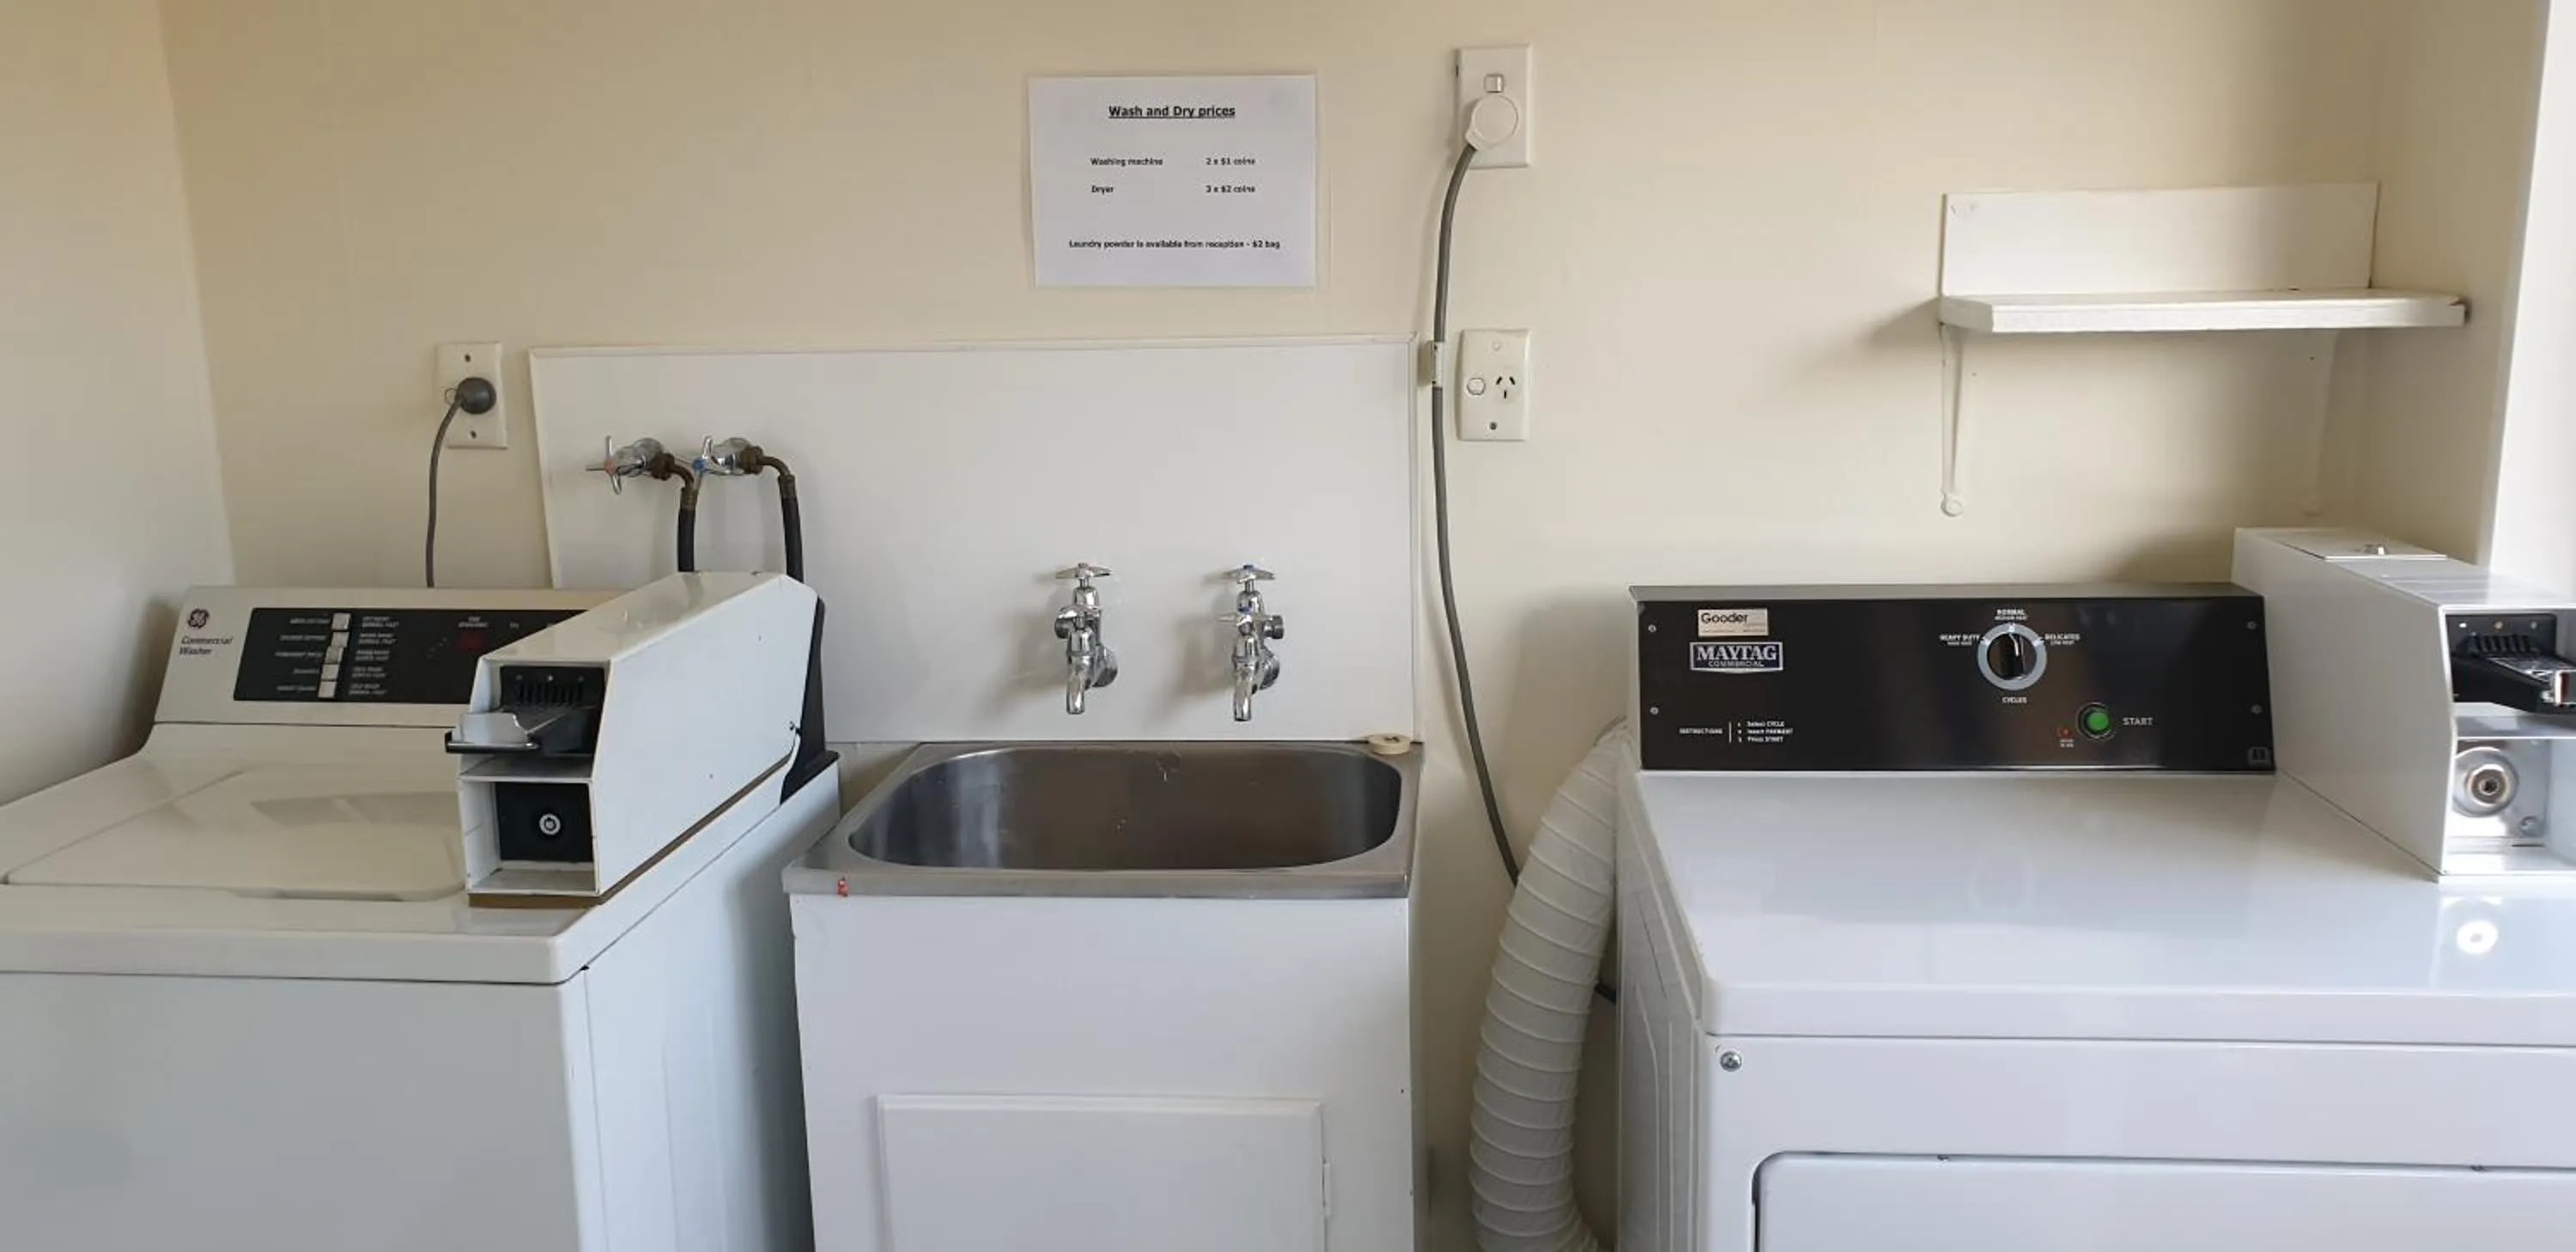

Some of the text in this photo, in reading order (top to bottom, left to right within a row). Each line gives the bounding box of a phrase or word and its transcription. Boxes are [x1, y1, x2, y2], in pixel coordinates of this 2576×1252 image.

[1109, 105, 1236, 119] Wash and Dry prices
[1090, 157, 1126, 167] Washing
[1091, 185, 1114, 195] Dryer
[1069, 240, 1102, 249] Laundry
[1701, 612, 1749, 624] Gooder
[1696, 645, 1777, 660] MAYTAG
[2122, 717, 2154, 726] START
